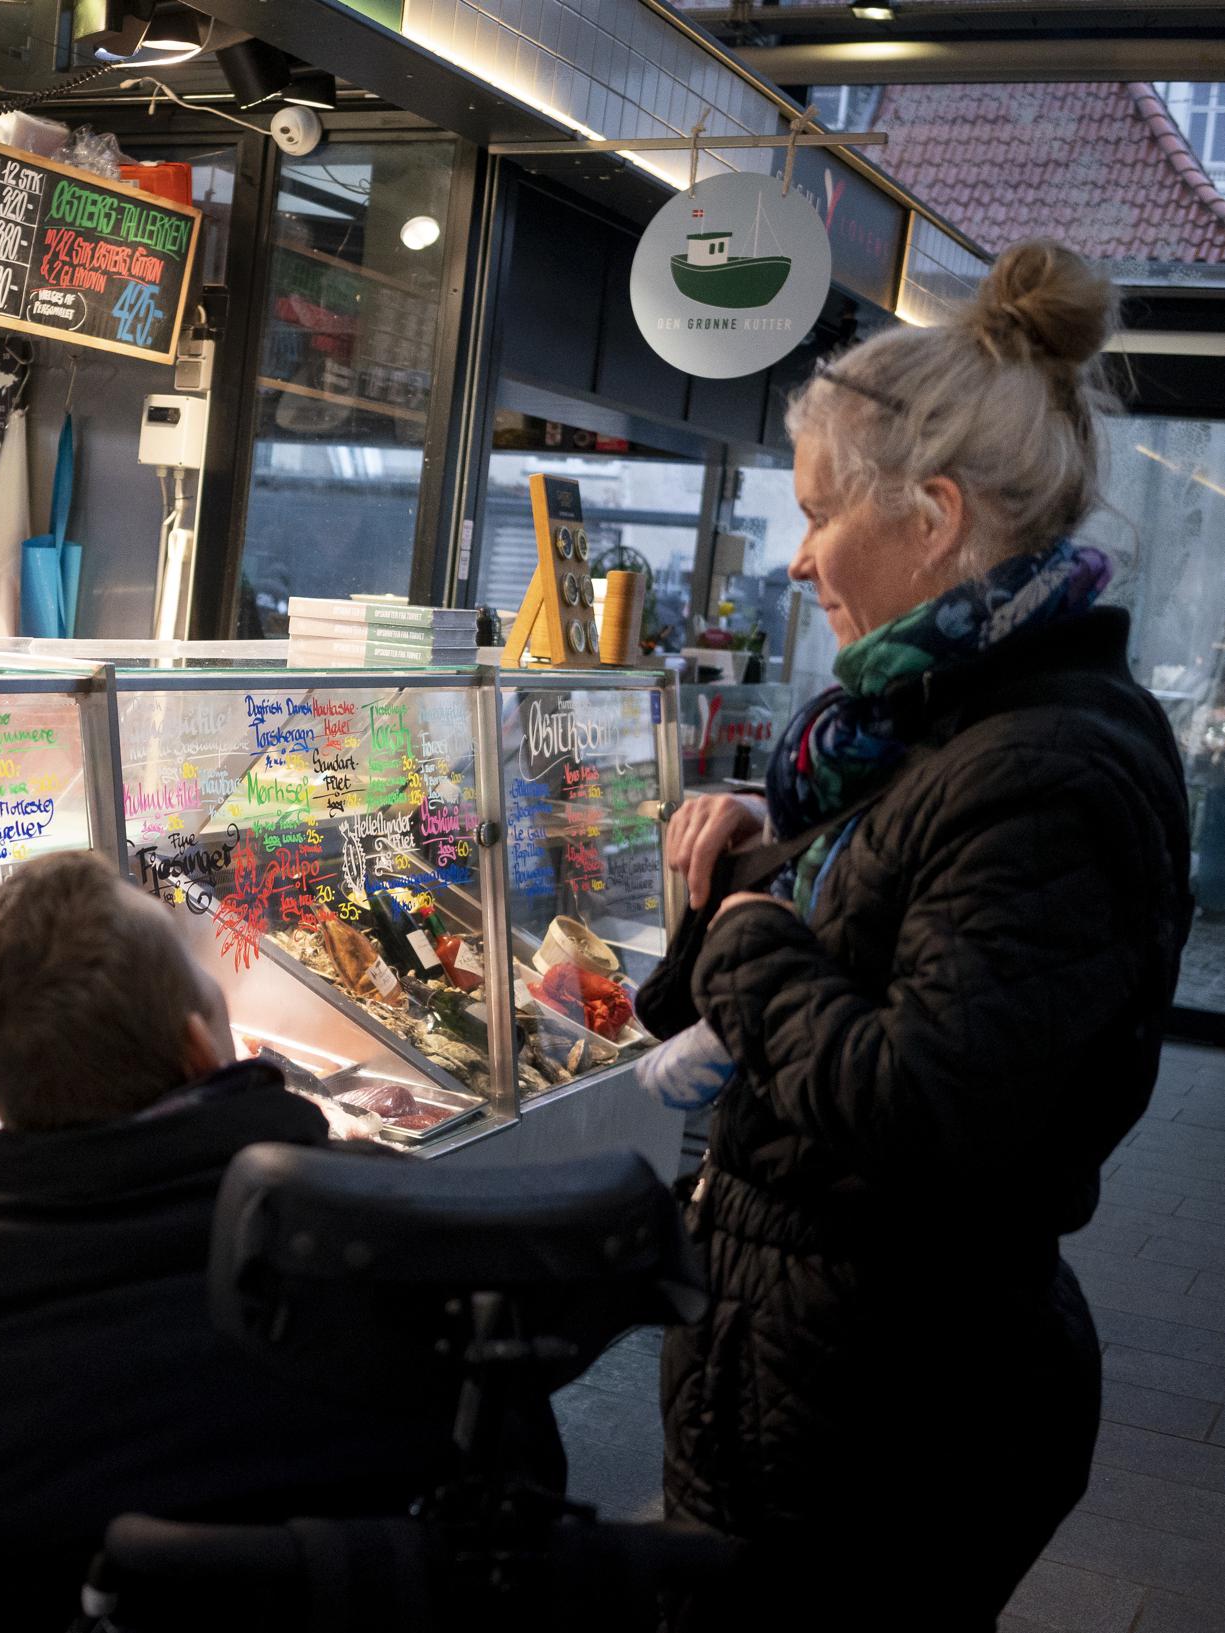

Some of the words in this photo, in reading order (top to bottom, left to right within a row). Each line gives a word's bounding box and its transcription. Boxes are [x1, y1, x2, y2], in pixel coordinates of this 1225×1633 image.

[656, 318, 681, 331] DEN
[687, 318, 738, 331] GRØNNE
[743, 318, 793, 331] KUTTER
